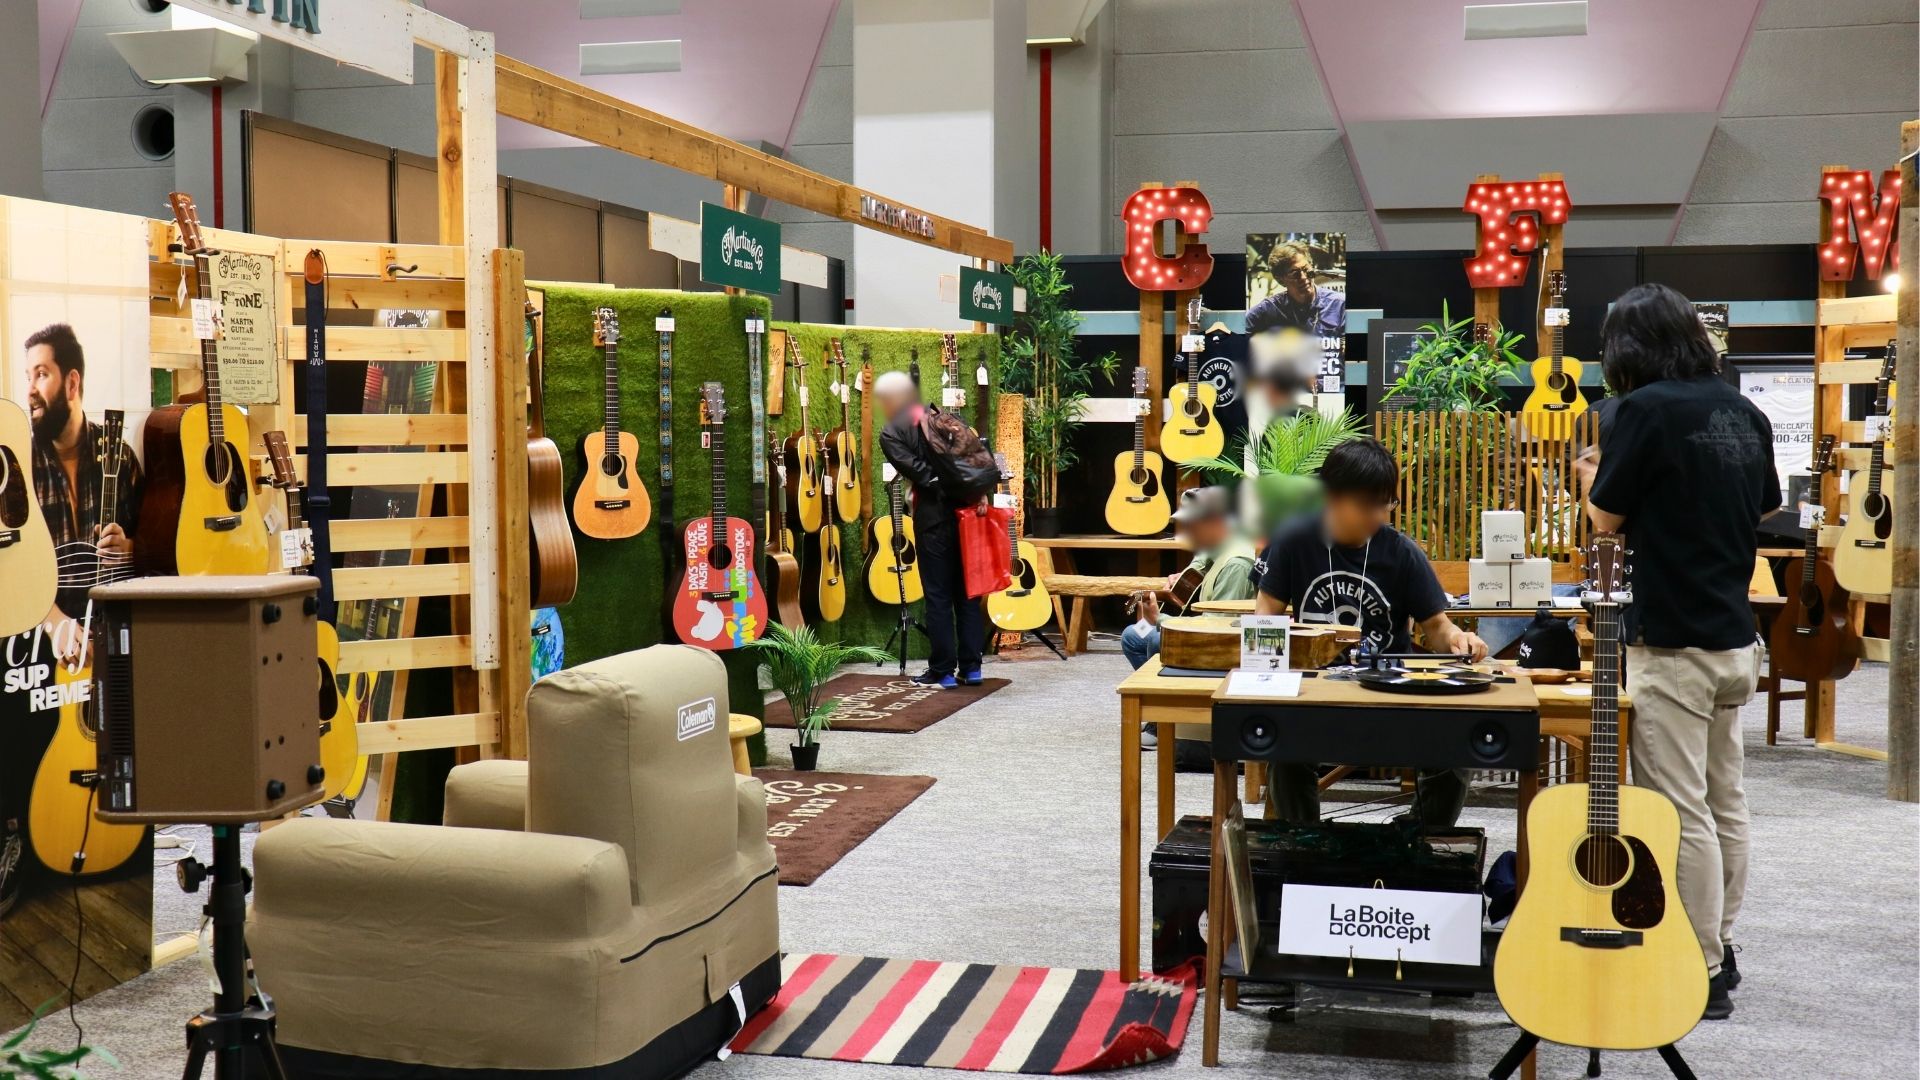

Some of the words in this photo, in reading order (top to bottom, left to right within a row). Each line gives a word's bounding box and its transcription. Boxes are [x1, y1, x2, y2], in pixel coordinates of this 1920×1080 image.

[1121, 187, 1214, 291] C
[1463, 181, 1572, 288] F
[234, 293, 263, 309] TONE
[230, 317, 254, 326] MARTIN
[230, 325, 254, 334] GUITAR
[1786, 422, 1814, 430] CLAPTO
[687, 530, 698, 559] PEACE
[697, 522, 708, 547] LOVE
[735, 527, 746, 587] WOODSTOCK
[688, 566, 699, 591] DAYS
[1313, 581, 1383, 617] AUTHENTIC
[4, 663, 50, 694] SUP
[29, 679, 92, 713] REME
[680, 708, 708, 732] Coleman
[1344, 922, 1431, 944] concept
